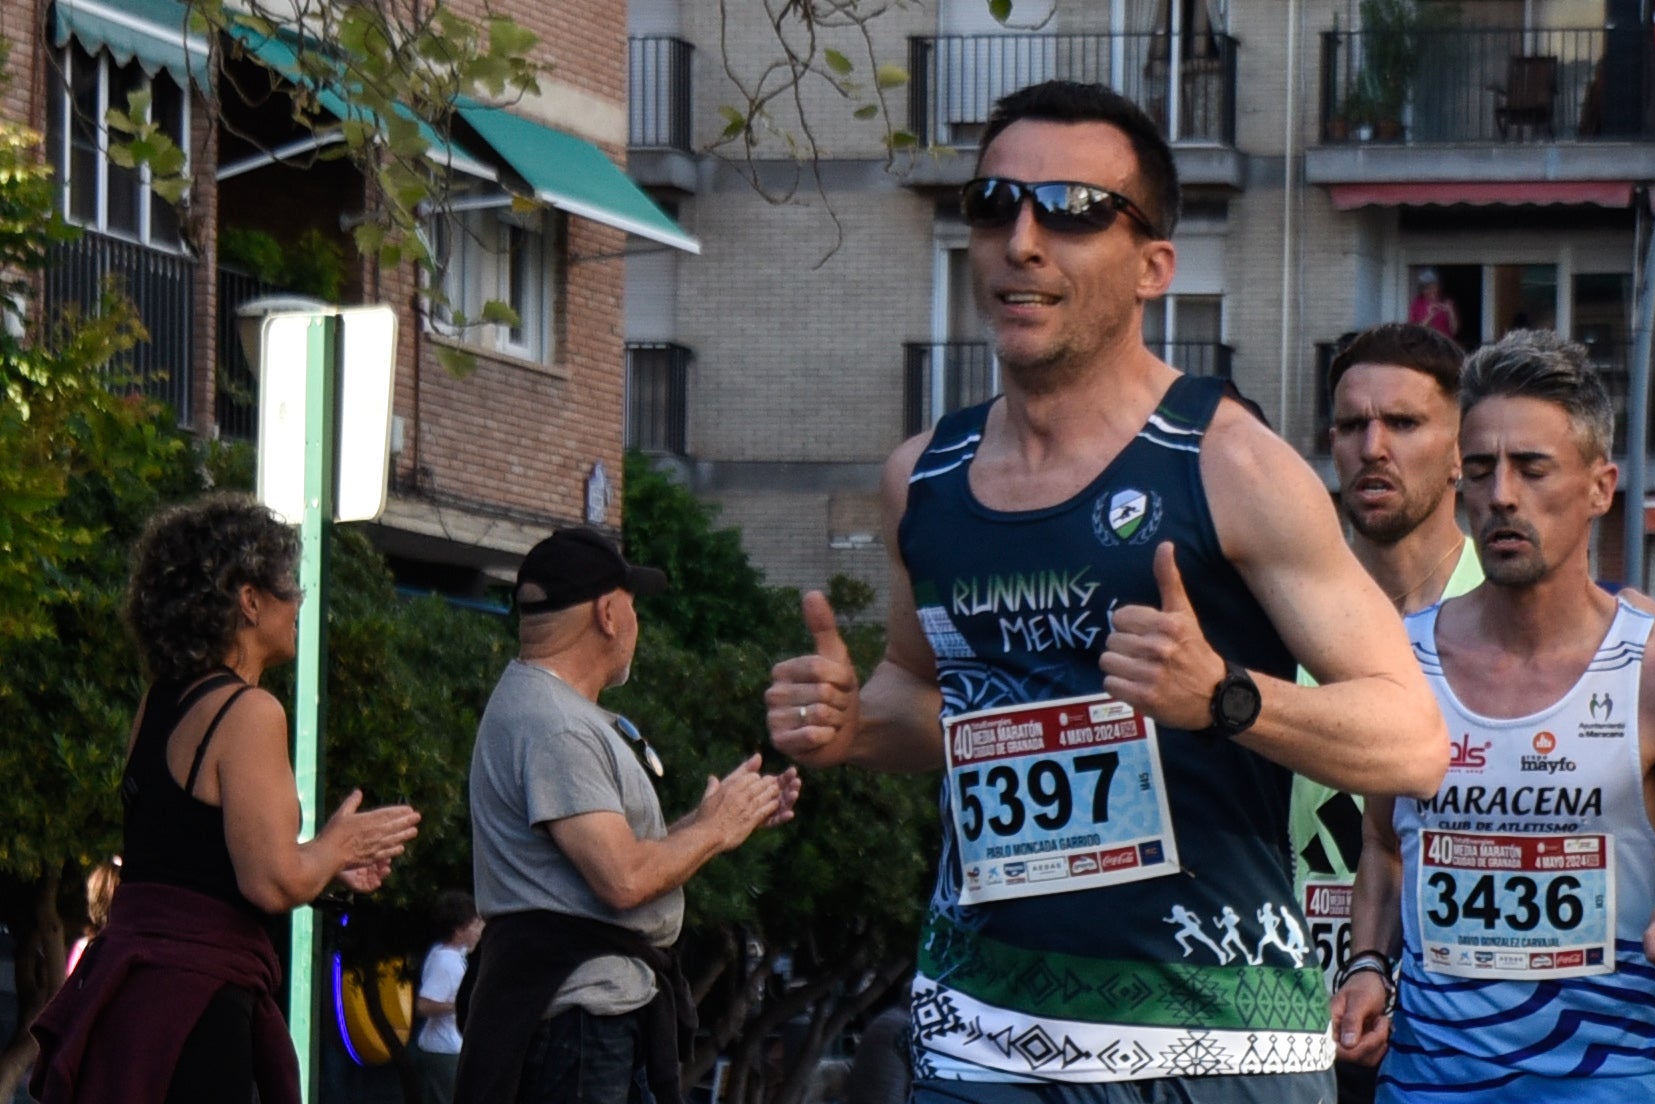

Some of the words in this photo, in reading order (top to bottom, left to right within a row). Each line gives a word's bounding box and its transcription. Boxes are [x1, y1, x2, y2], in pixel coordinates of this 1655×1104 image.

[953, 565, 1101, 616] RUNNING
[953, 723, 973, 762] 40
[1060, 730, 1067, 746] 4
[1067, 727, 1093, 745] MAYO
[1094, 723, 1121, 742] 2024
[1520, 757, 1576, 775] mayfo
[958, 751, 1120, 842] 5397
[1416, 785, 1602, 816] MARACENA
[1438, 820, 1471, 830] CLUB
[1475, 821, 1493, 831] DE
[1496, 821, 1578, 833] ATLETISMO
[1428, 835, 1453, 864] 40
[1310, 888, 1330, 915] 40
[1427, 871, 1583, 931] 3436
